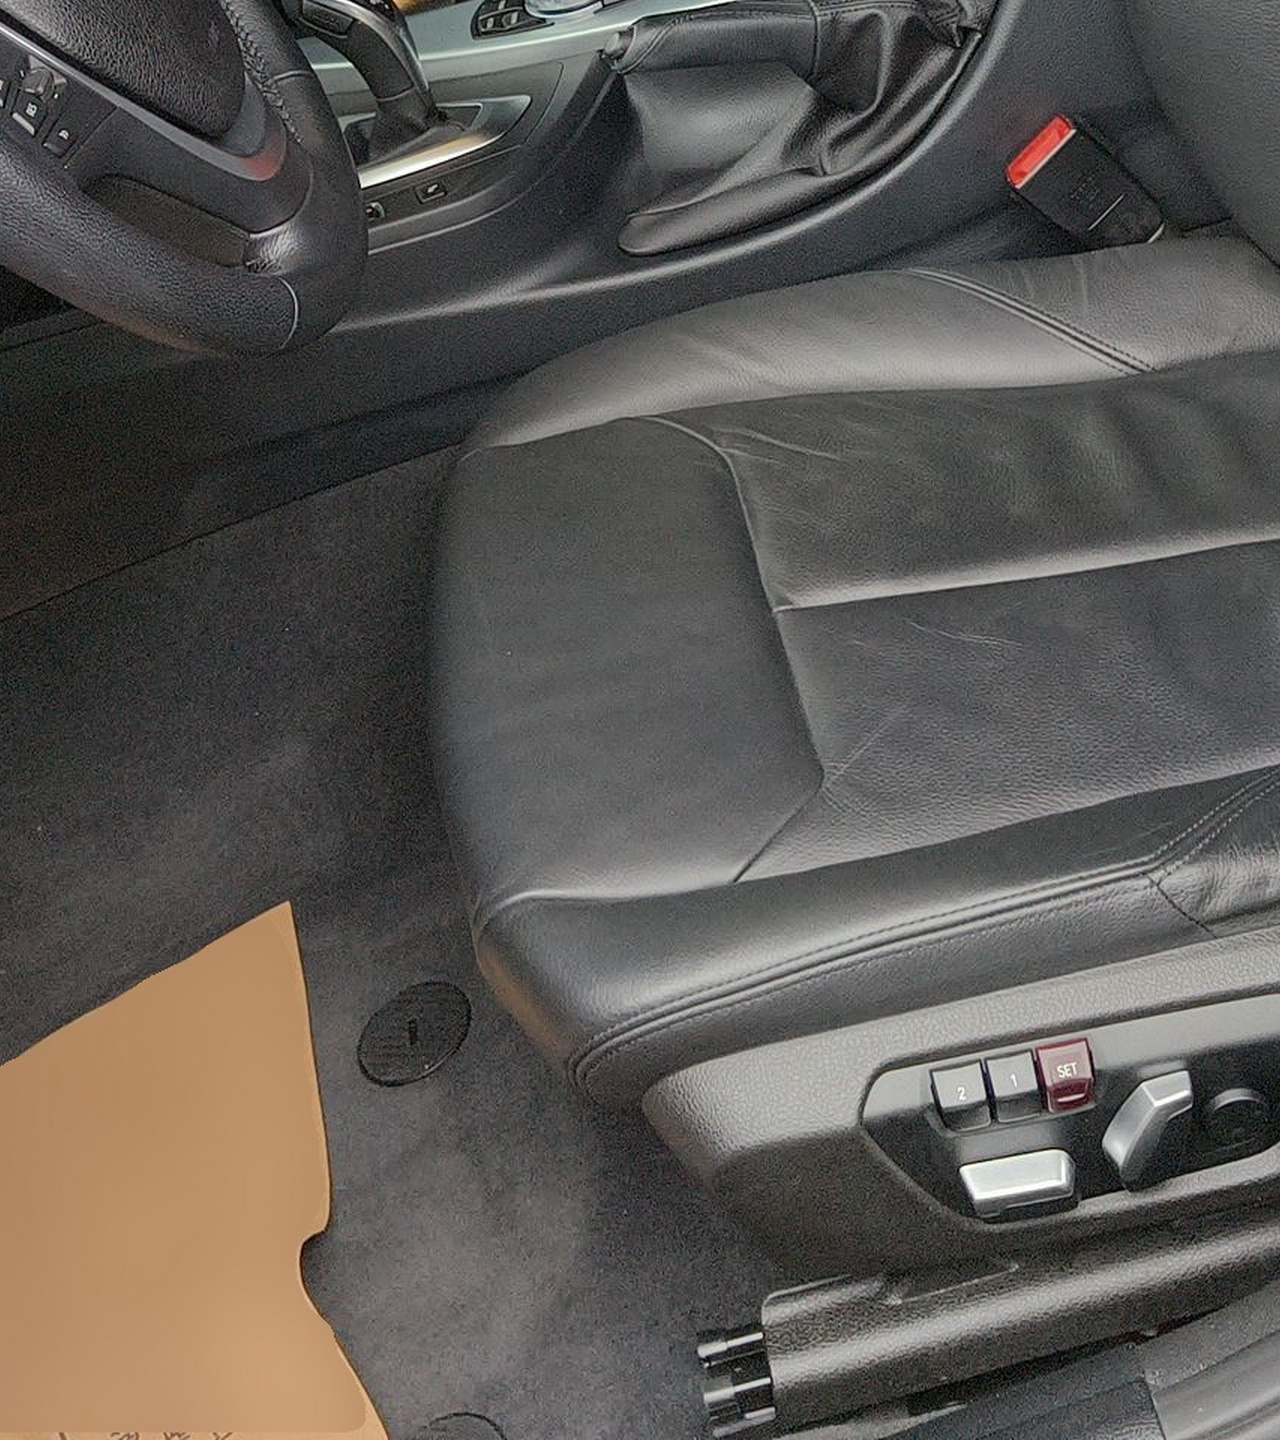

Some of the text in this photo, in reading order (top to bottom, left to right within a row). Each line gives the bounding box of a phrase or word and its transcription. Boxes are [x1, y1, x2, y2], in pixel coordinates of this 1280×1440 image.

[956, 1061, 1078, 1101] 2 1 SET
